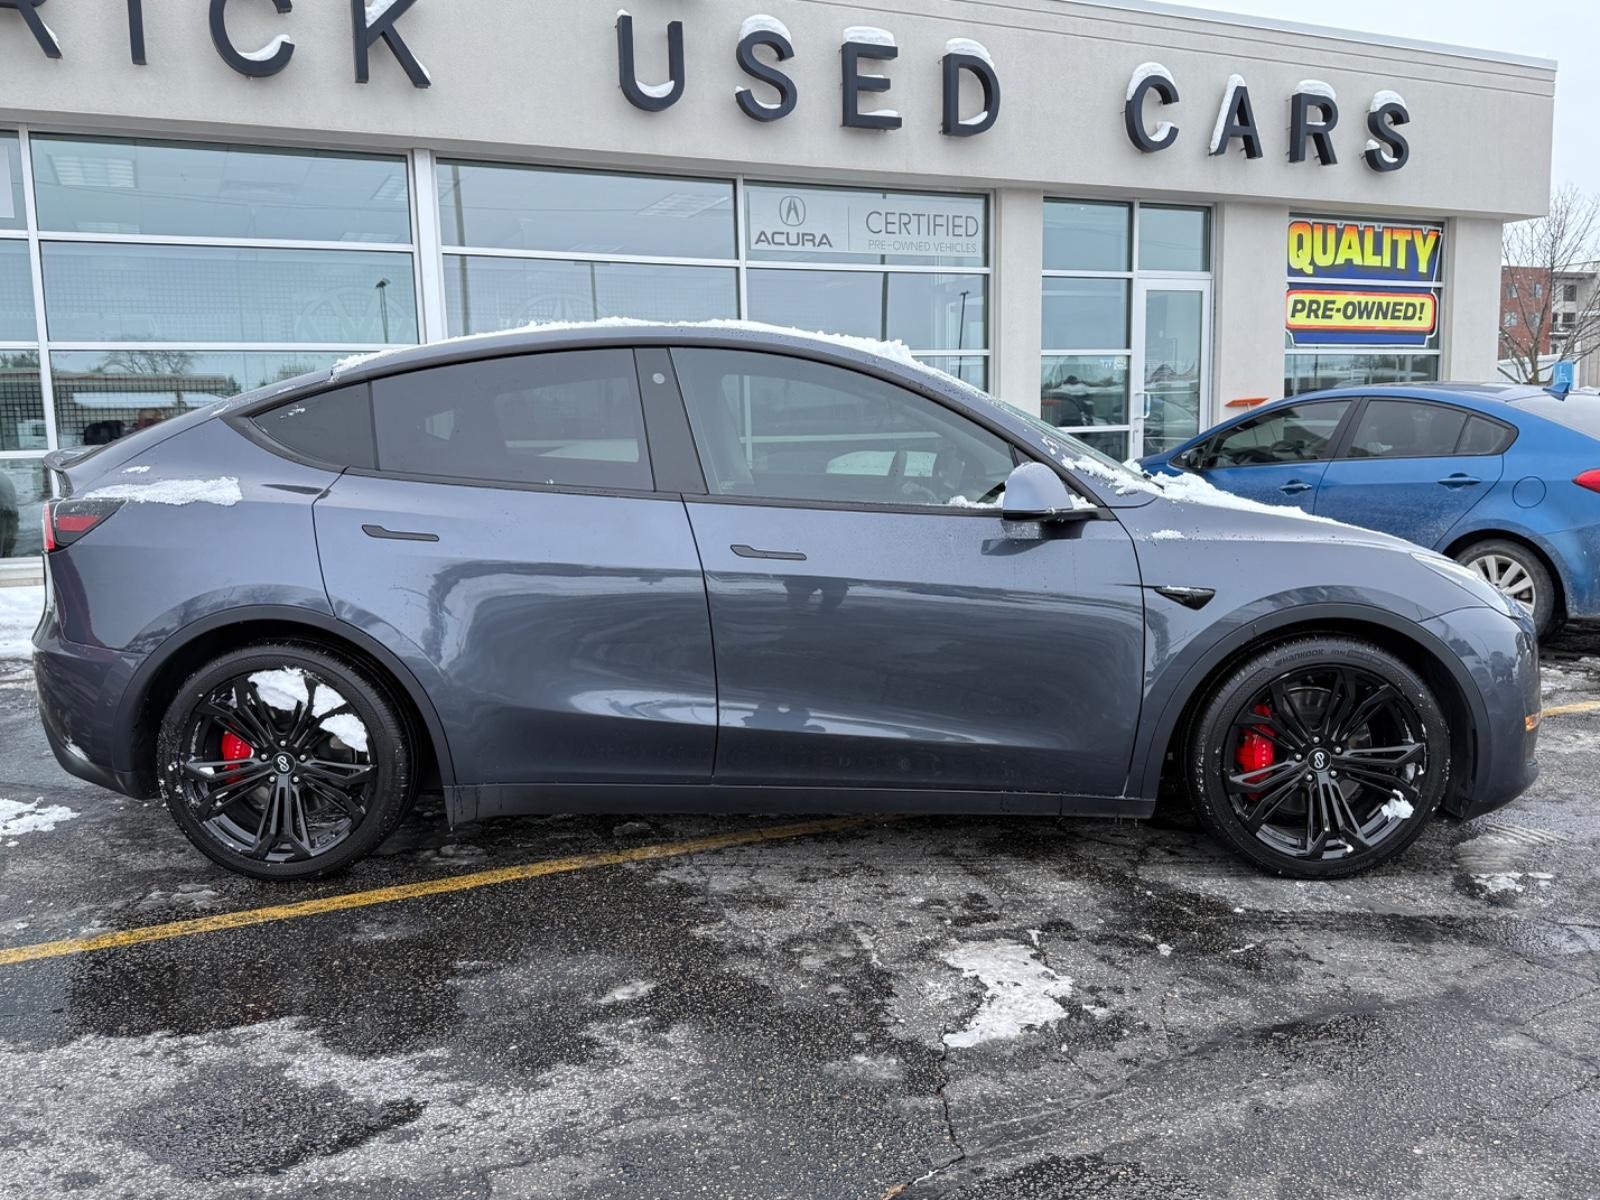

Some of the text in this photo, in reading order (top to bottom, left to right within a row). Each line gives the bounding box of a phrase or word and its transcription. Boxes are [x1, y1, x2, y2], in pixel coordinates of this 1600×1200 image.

[616, 14, 1002, 138] USED
[1125, 66, 1410, 172] CARS
[865, 210, 979, 238] CERTIFIED
[754, 230, 834, 248] ACURA
[868, 239, 977, 253] PRE-OWNED VEHICLES
[1288, 221, 1439, 274] QUALITY
[1290, 299, 1425, 321] PRE-OWNED!
